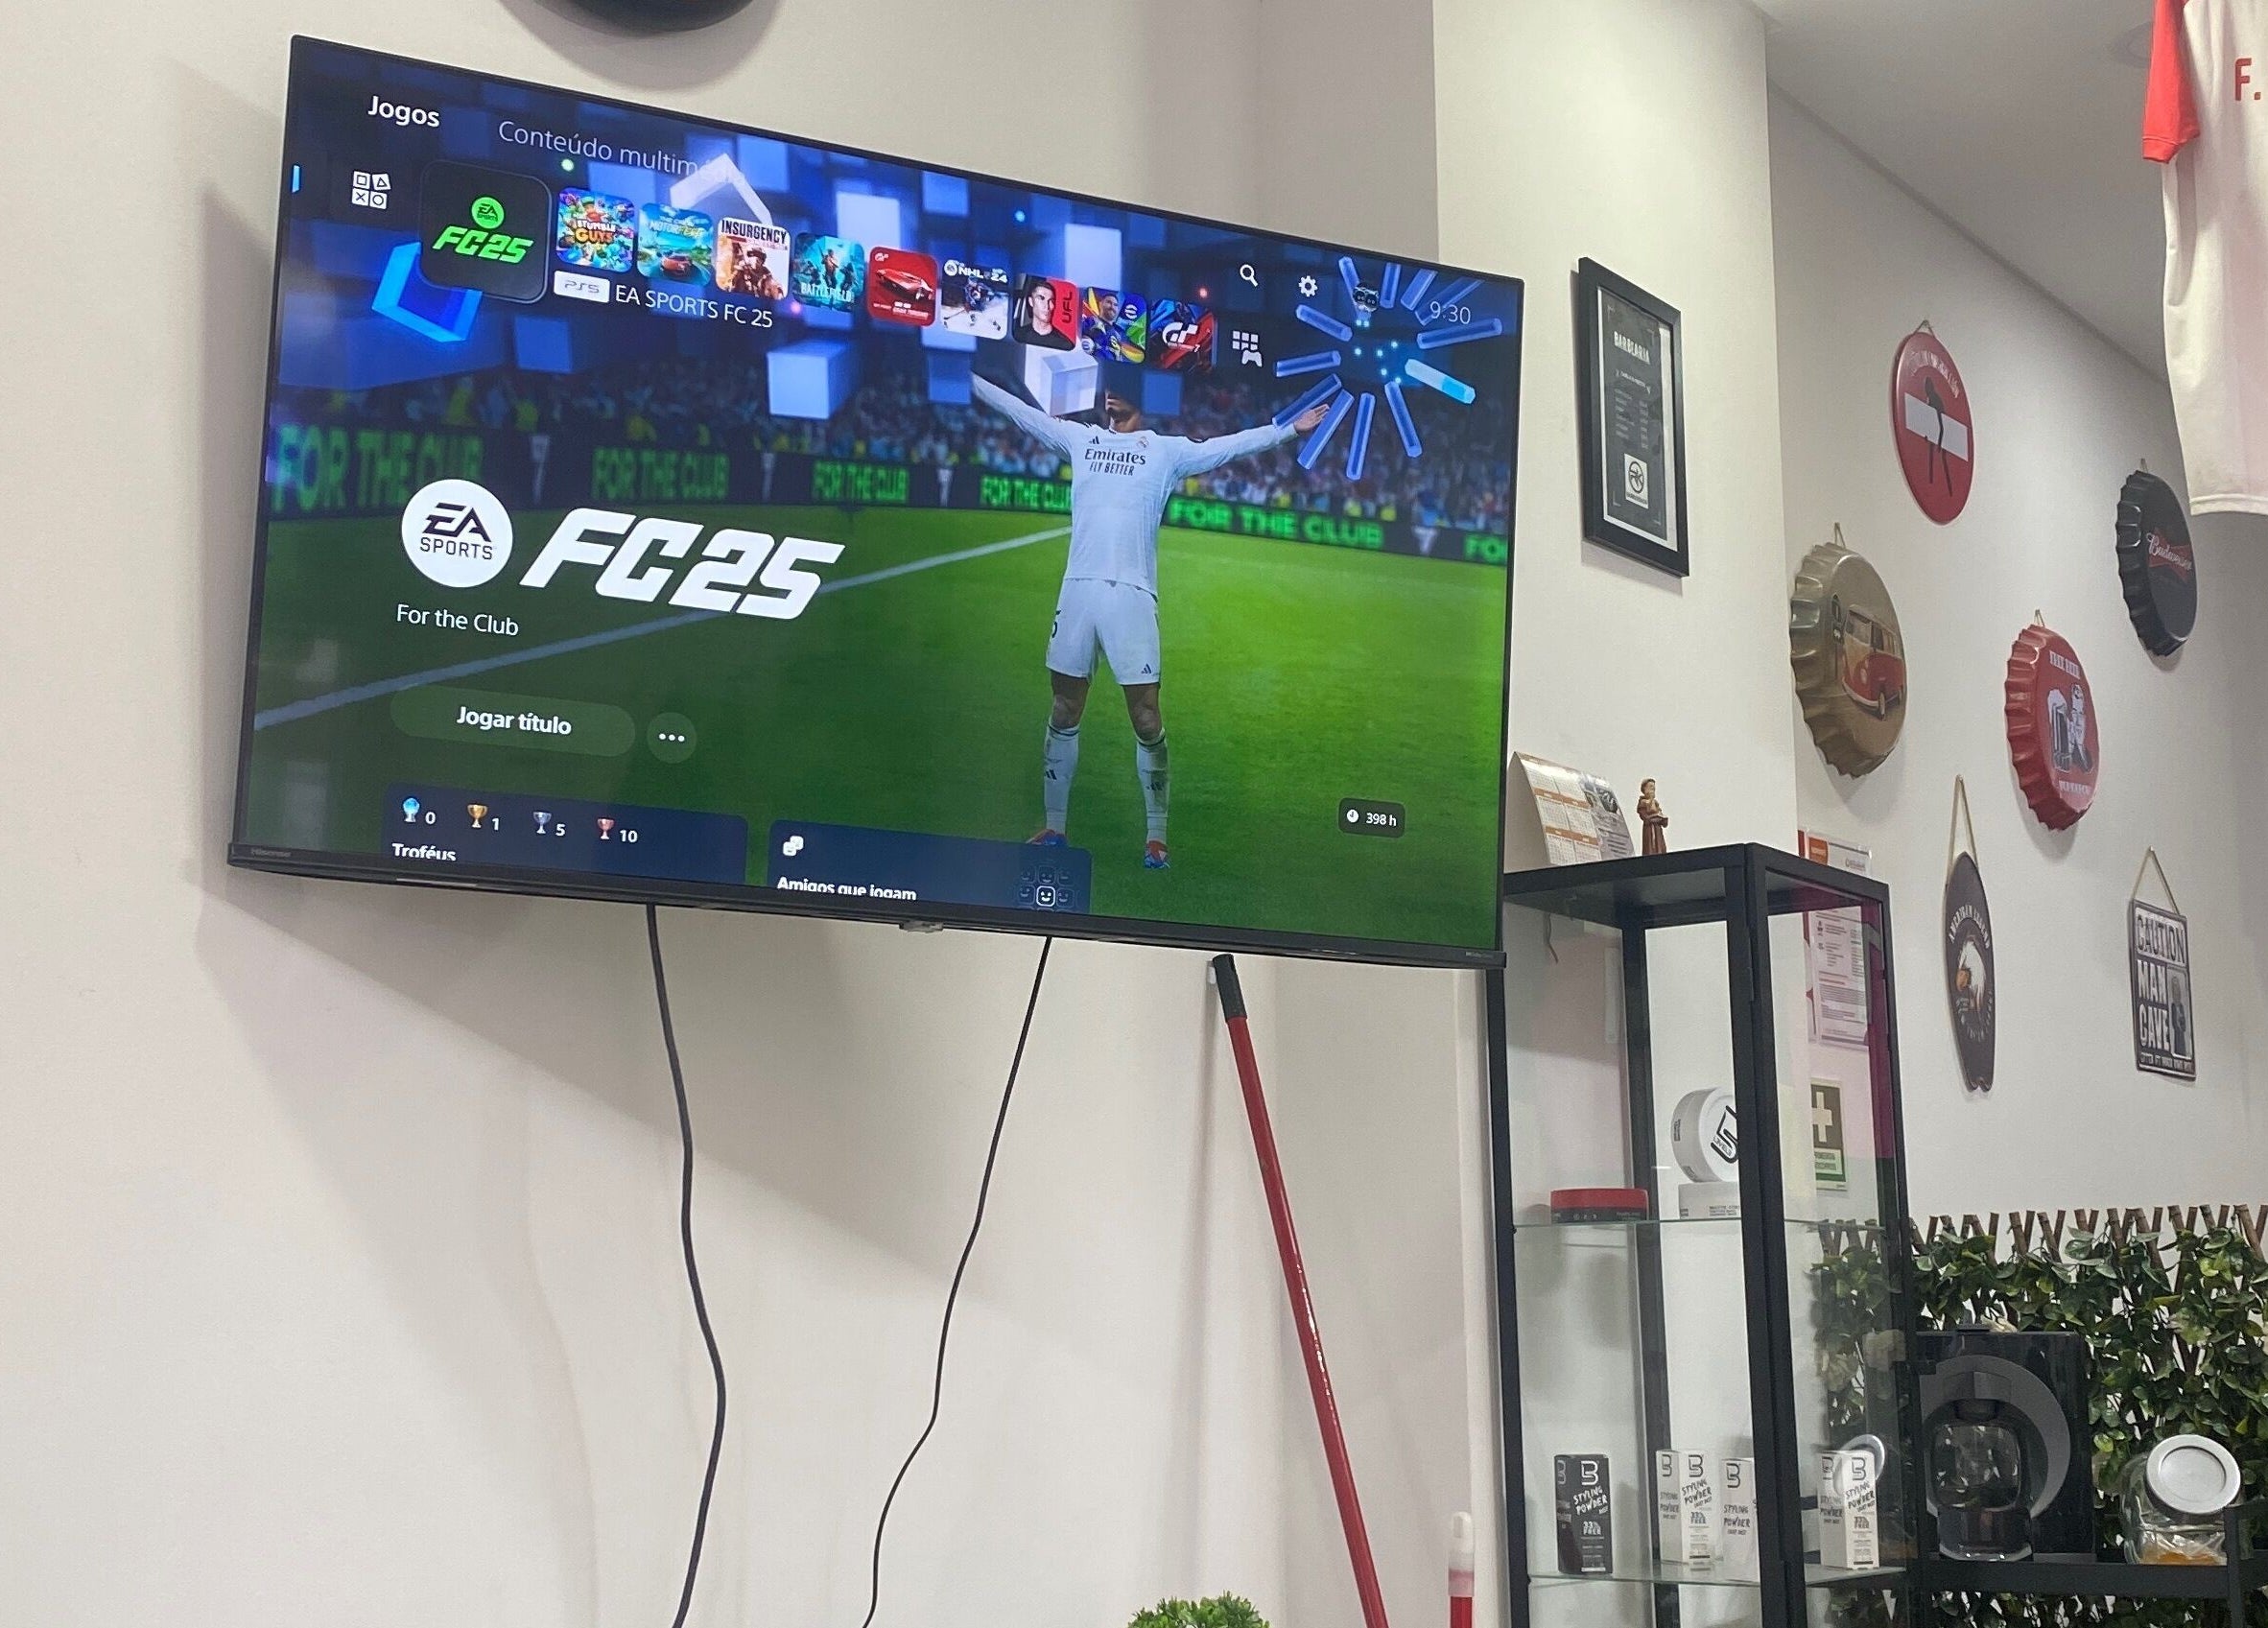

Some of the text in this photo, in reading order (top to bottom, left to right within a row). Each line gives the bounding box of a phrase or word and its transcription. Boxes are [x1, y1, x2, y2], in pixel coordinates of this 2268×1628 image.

[367, 95, 440, 127] Jogos
[498, 121, 612, 161] Conteúdo
[576, 228, 614, 245] GUYS
[721, 220, 788, 245] INSURGENCY
[958, 267, 983, 279] NHL
[564, 279, 773, 328] PS5 EA SPORTS FC 25
[1062, 291, 1073, 323] UFL
[1429, 300, 1471, 324] 9:30
[1085, 448, 1146, 465] Emirates
[1090, 461, 1135, 476] FLY BETTER
[422, 502, 492, 543] EA
[1169, 497, 1383, 549] FOR THE CLUB
[420, 536, 493, 560] SPORTS
[396, 604, 519, 637] For the Club
[457, 707, 572, 736] Jogar título
[425, 812, 638, 843] 0 1 5 10
[1365, 812, 1397, 826] 398 h
[391, 842, 457, 861] Troféus
[777, 876, 835, 894] Amigos
[2137, 913, 2185, 964] CAUTION
[2137, 959, 2167, 1004] MAN
[2139, 1003, 2170, 1050] CAVE
[1575, 1494, 1608, 1516] POWDER
[1685, 1486, 1712, 1505] POWDER
